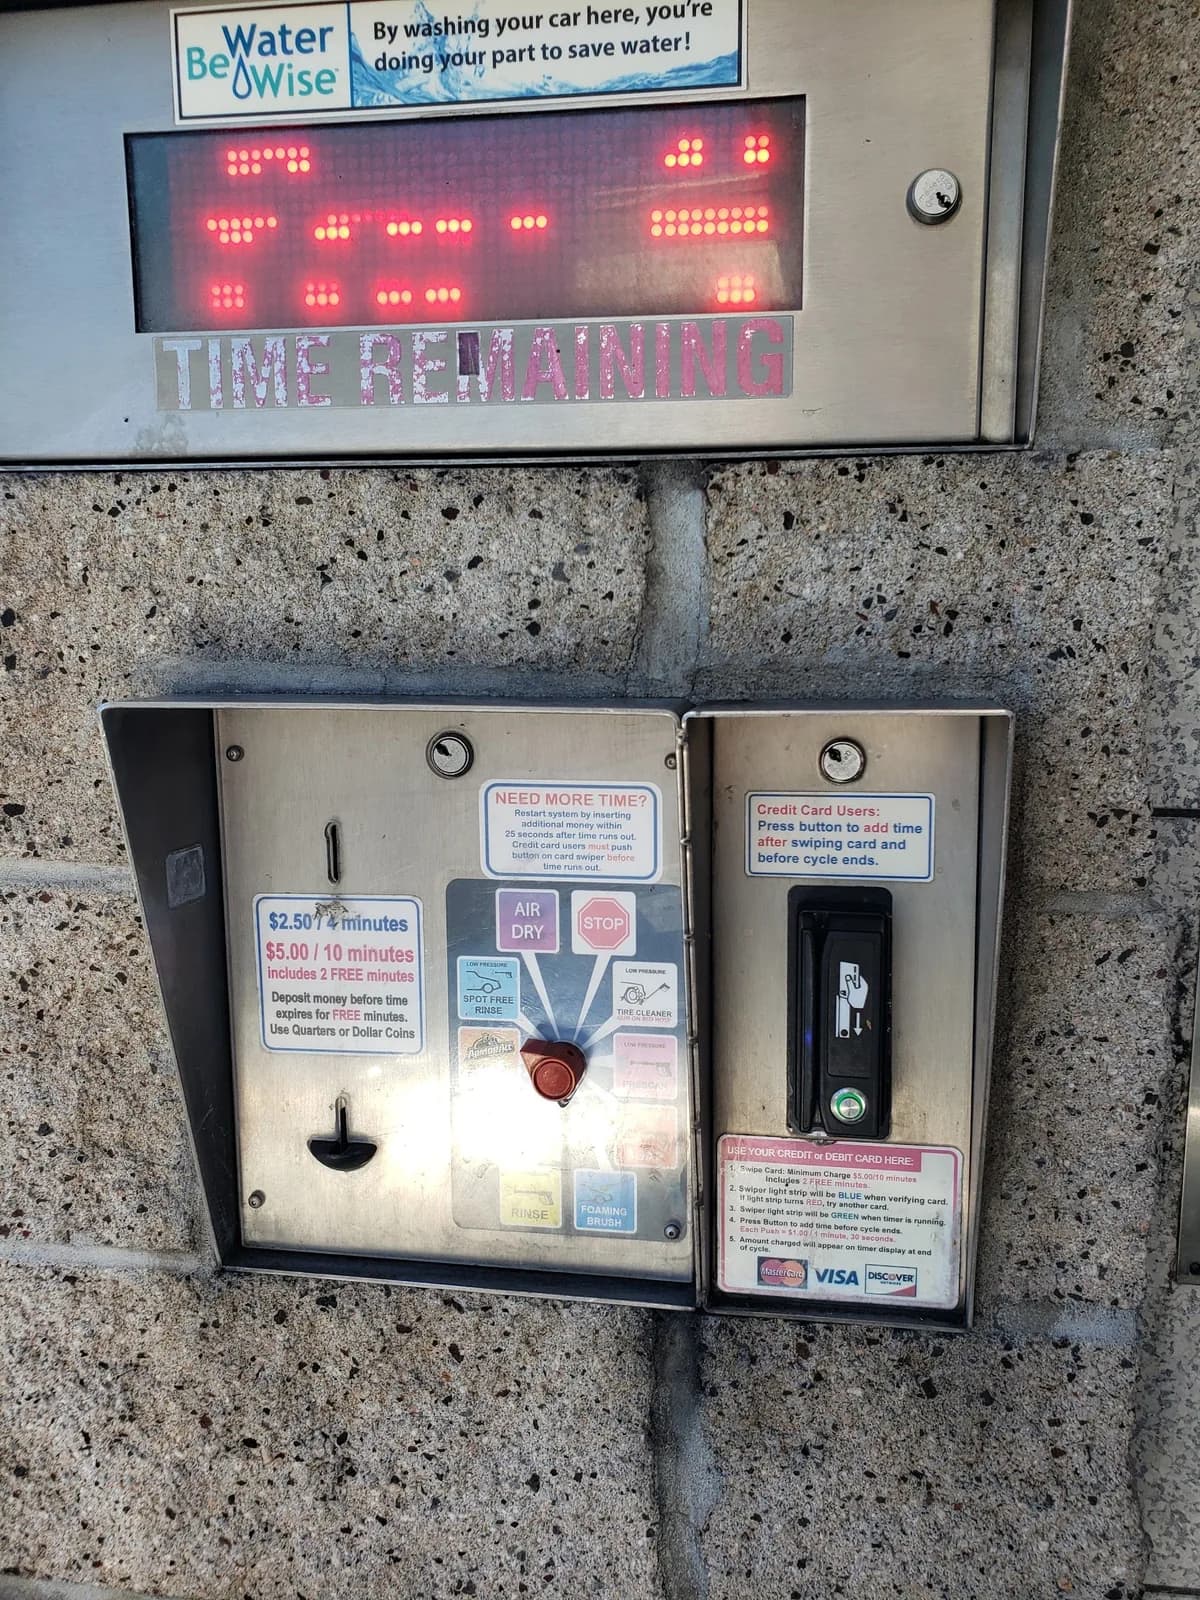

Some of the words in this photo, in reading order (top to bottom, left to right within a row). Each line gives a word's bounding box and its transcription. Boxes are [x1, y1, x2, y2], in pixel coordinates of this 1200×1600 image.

[374, 22, 398, 44] By
[404, 16, 489, 38] washing
[496, 14, 543, 37] your
[550, 12, 580, 27] car
[587, 5, 640, 25] here,
[646, 1, 713, 26] you're
[221, 23, 334, 59] Water
[375, 52, 433, 73] doing
[440, 50, 486, 72] your
[492, 44, 535, 69] part
[541, 43, 562, 60] to
[568, 41, 615, 59] save
[621, 32, 691, 55] water!
[187, 46, 230, 81] Be
[251, 62, 337, 99] Wise
[162, 334, 331, 410] TIME
[360, 318, 785, 405] REMAINING
[495, 791, 540, 805] NEED
[546, 793, 593, 806] MORE
[598, 794, 647, 808] TIME?
[514, 809, 546, 818] Restart
[548, 811, 579, 820] system
[580, 811, 591, 820] by
[593, 811, 631, 821] inserting
[757, 804, 797, 815] Credit
[800, 805, 832, 816] Card
[837, 805, 880, 817] Users:
[521, 820, 564, 829] additional
[566, 823, 594, 831] money
[596, 822, 622, 830] within
[758, 820, 794, 832] Press
[800, 821, 842, 833] button
[847, 822, 859, 833] to
[863, 823, 889, 833] add
[893, 823, 923, 834] time
[505, 830, 516, 838] 25
[517, 831, 553, 839] seconds
[555, 831, 576, 839] after
[578, 832, 597, 840] time
[620, 833, 636, 841] out.
[512, 841, 539, 849] Credit
[540, 842, 560, 850] card
[611, 843, 632, 852] push
[758, 836, 788, 847] after
[791, 837, 843, 851] swiping
[847, 839, 877, 849] card
[880, 839, 906, 850] and
[512, 852, 539, 860] button
[576, 854, 605, 862] swiper
[607, 854, 635, 862] before
[758, 852, 799, 863] before
[803, 854, 838, 866] cycle
[842, 855, 879, 866] ends.
[585, 864, 600, 872] out.
[514, 902, 541, 917] AIR
[269, 911, 312, 932] $2.50
[341, 914, 409, 932] minutes
[583, 917, 624, 930] STOP
[511, 924, 545, 940] DRY
[266, 941, 309, 961] $5.00
[313, 943, 319, 961] /
[324, 944, 343, 961] 10
[348, 944, 415, 963] minutes
[267, 966, 317, 980] includes
[320, 968, 327, 980] 2
[331, 968, 364, 981] FREE
[367, 969, 415, 983] minutes
[271, 991, 311, 1005] Deposit
[313, 995, 347, 1006] money
[350, 993, 383, 1005] before
[385, 994, 408, 1006] time
[464, 995, 488, 1003] SPOT
[490, 996, 514, 1004] FREE
[276, 1008, 313, 1021] expires
[315, 1009, 330, 1020] for
[332, 1009, 361, 1021] FREE
[363, 1011, 408, 1022] minutes.
[475, 1006, 503, 1015] RINSE
[270, 1023, 290, 1035] Use
[292, 1024, 336, 1036] Quarters
[339, 1027, 350, 1037] or
[352, 1026, 383, 1038] Dollar
[385, 1026, 415, 1039] Coins
[728, 1146, 746, 1155] USE
[748, 1148, 775, 1157] YOUR
[778, 1149, 813, 1159] CREDIT
[825, 1152, 853, 1162] DEBIT
[855, 1154, 882, 1163] CARD
[885, 1157, 914, 1165] HERE:
[766, 1176, 800, 1184] Includes
[787, 1169, 821, 1177] Minimum
[824, 1171, 851, 1179] Charge
[739, 1185, 766, 1193] Swiper
[769, 1187, 787, 1195] light
[789, 1188, 807, 1197] strip
[888, 1196, 925, 1205] verifying
[511, 1208, 549, 1220] RINSE
[581, 1205, 627, 1216] FOAMING
[740, 1206, 765, 1214] Swiper
[768, 1208, 784, 1216] light
[786, 1209, 803, 1217] strip
[831, 1212, 859, 1220] GREEN
[587, 1217, 622, 1227] BRUSH
[740, 1236, 769, 1244] Amount
[771, 1238, 800, 1247] charged
[818, 1242, 843, 1250] appear
[879, 1246, 905, 1255] display
[816, 1268, 859, 1285] VISA
[868, 1272, 913, 1282] DISCOVER
